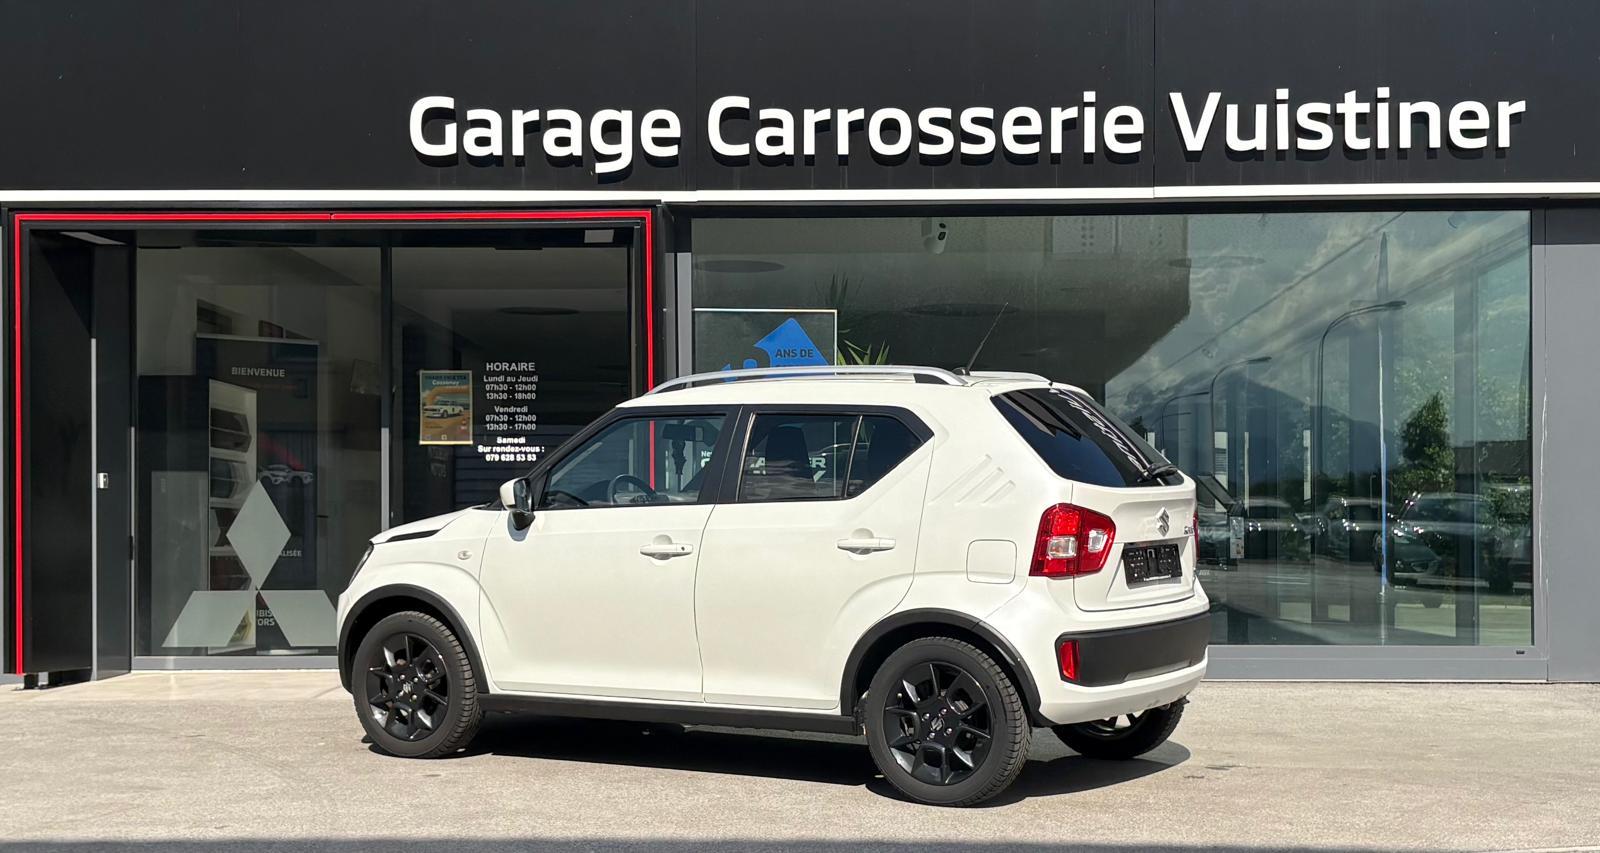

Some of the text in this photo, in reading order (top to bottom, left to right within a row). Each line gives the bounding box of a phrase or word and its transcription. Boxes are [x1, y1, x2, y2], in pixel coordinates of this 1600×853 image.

[409, 86, 1526, 173] Garage Carrosserie Vuistiner
[775, 348, 814, 358] ANS DE
[486, 362, 536, 371] HORAIRE
[231, 366, 287, 377] BIENVENUE
[485, 383, 508, 391] 07h30
[514, 383, 537, 391] 12h00
[486, 392, 508, 400] 13h30
[514, 392, 536, 400] 18h00
[494, 405, 528, 413] Vendredi
[485, 414, 508, 422] 07h30
[514, 414, 537, 422] 12h00
[496, 436, 526, 444] Samedi
[477, 444, 492, 453] Sur
[492, 444, 541, 453] rendez-vous
[485, 453, 537, 461] 079 628 53 53
